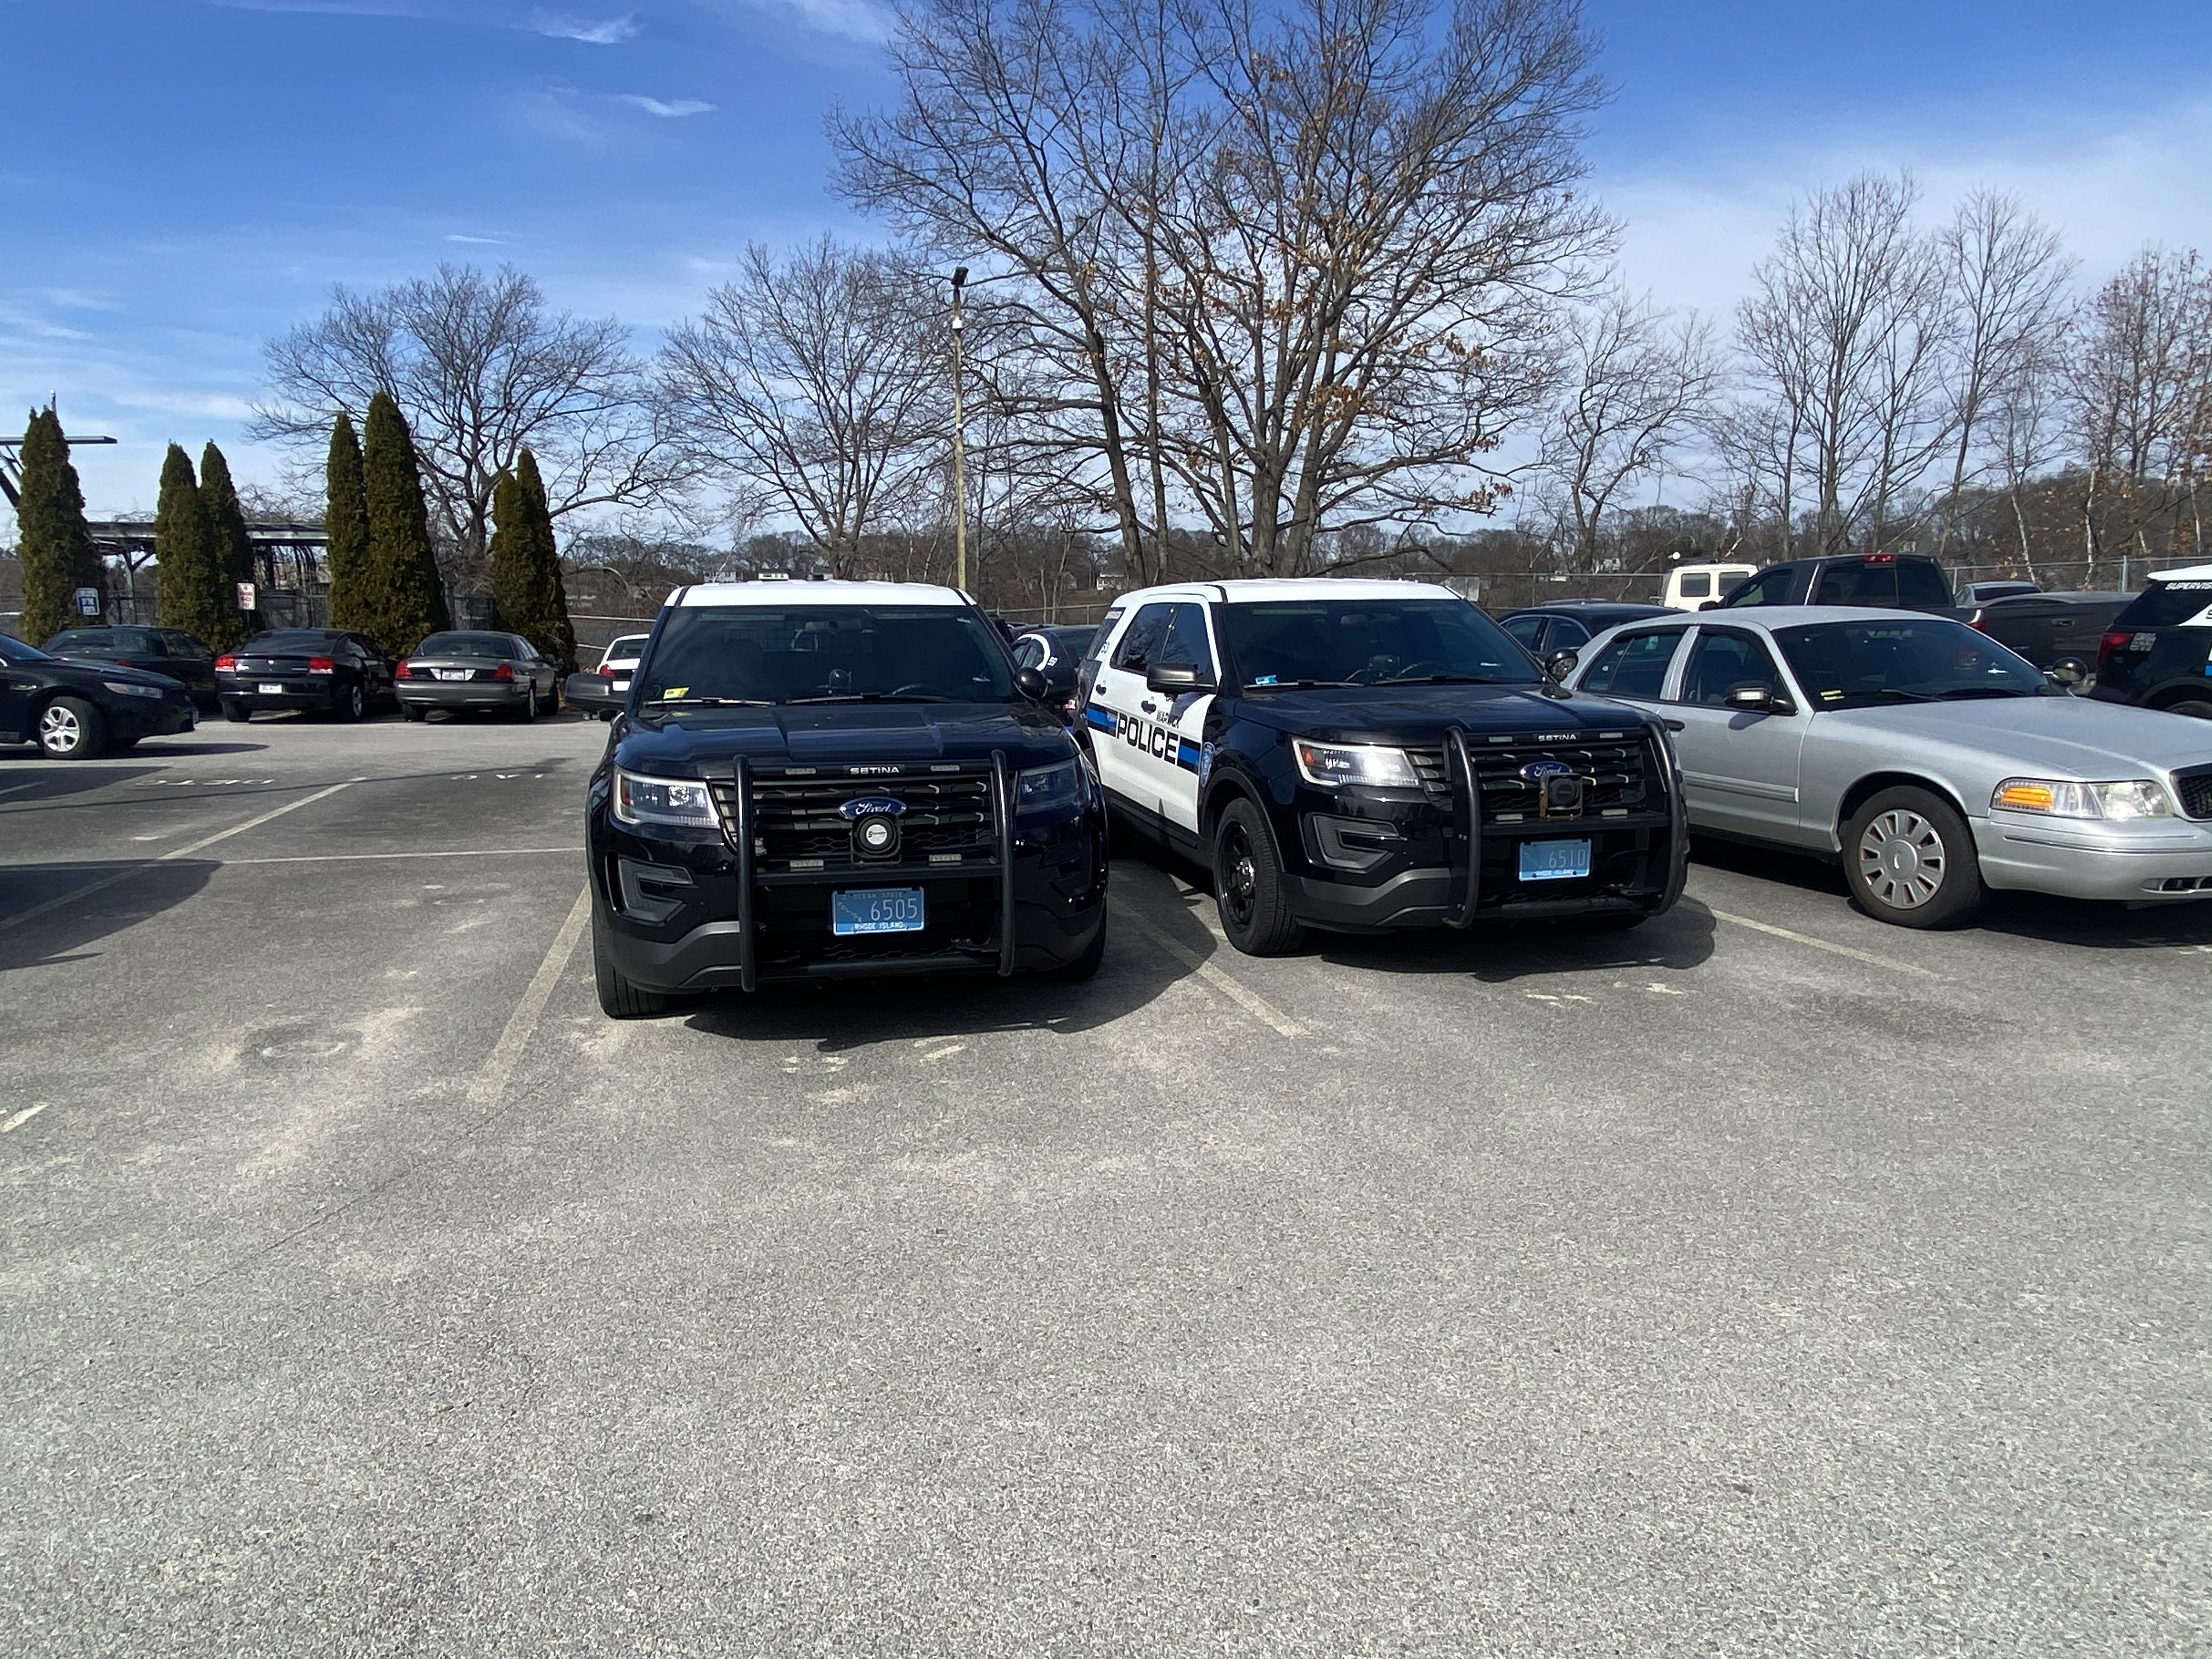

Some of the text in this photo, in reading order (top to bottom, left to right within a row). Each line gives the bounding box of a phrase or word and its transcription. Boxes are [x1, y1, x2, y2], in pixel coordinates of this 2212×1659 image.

[1117, 713, 1178, 765] POLICE
[1534, 765, 1562, 777] Ford
[855, 803, 892, 815] Ford
[1549, 849, 1585, 868] 6510
[871, 898, 918, 921] 6505
